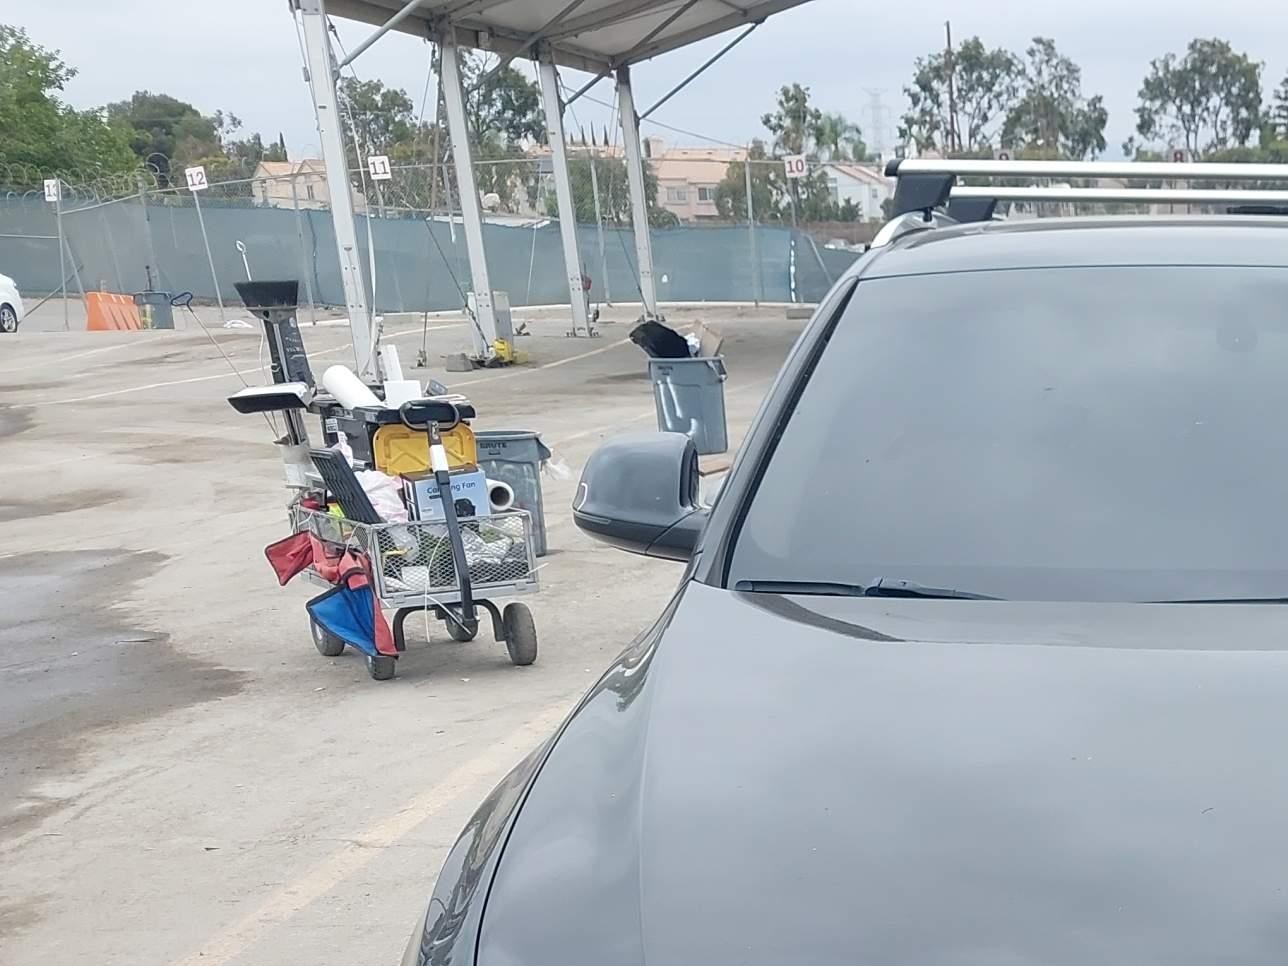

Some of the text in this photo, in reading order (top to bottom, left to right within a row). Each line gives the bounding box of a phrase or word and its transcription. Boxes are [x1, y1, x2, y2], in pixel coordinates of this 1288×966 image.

[370, 161, 389, 175] 11
[787, 159, 804, 173] 10
[188, 171, 206, 186] 12
[462, 481, 476, 489] Fan
